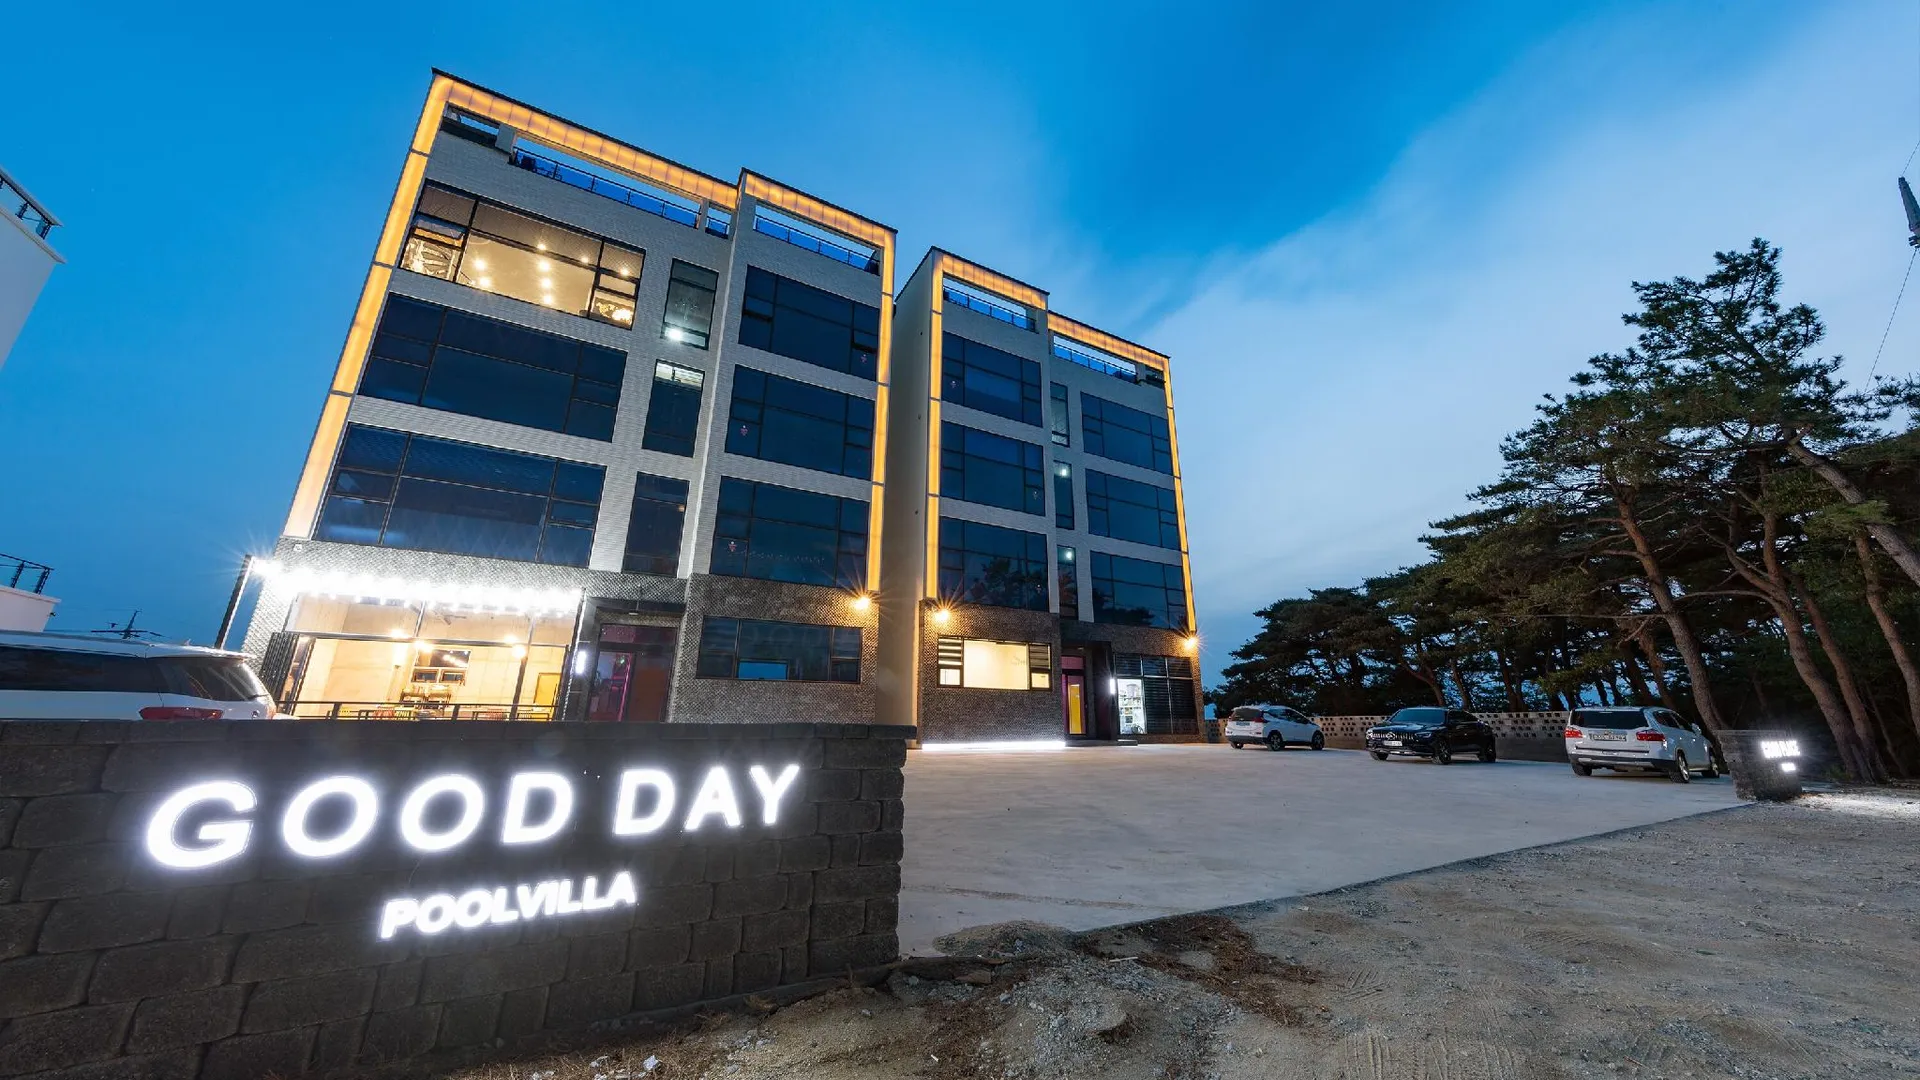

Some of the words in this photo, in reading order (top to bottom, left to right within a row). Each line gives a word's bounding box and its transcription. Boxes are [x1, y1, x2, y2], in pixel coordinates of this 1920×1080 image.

[144, 771, 575, 870] GOOD
[612, 764, 800, 836] DAY
[379, 871, 638, 939] POOLVILLA
